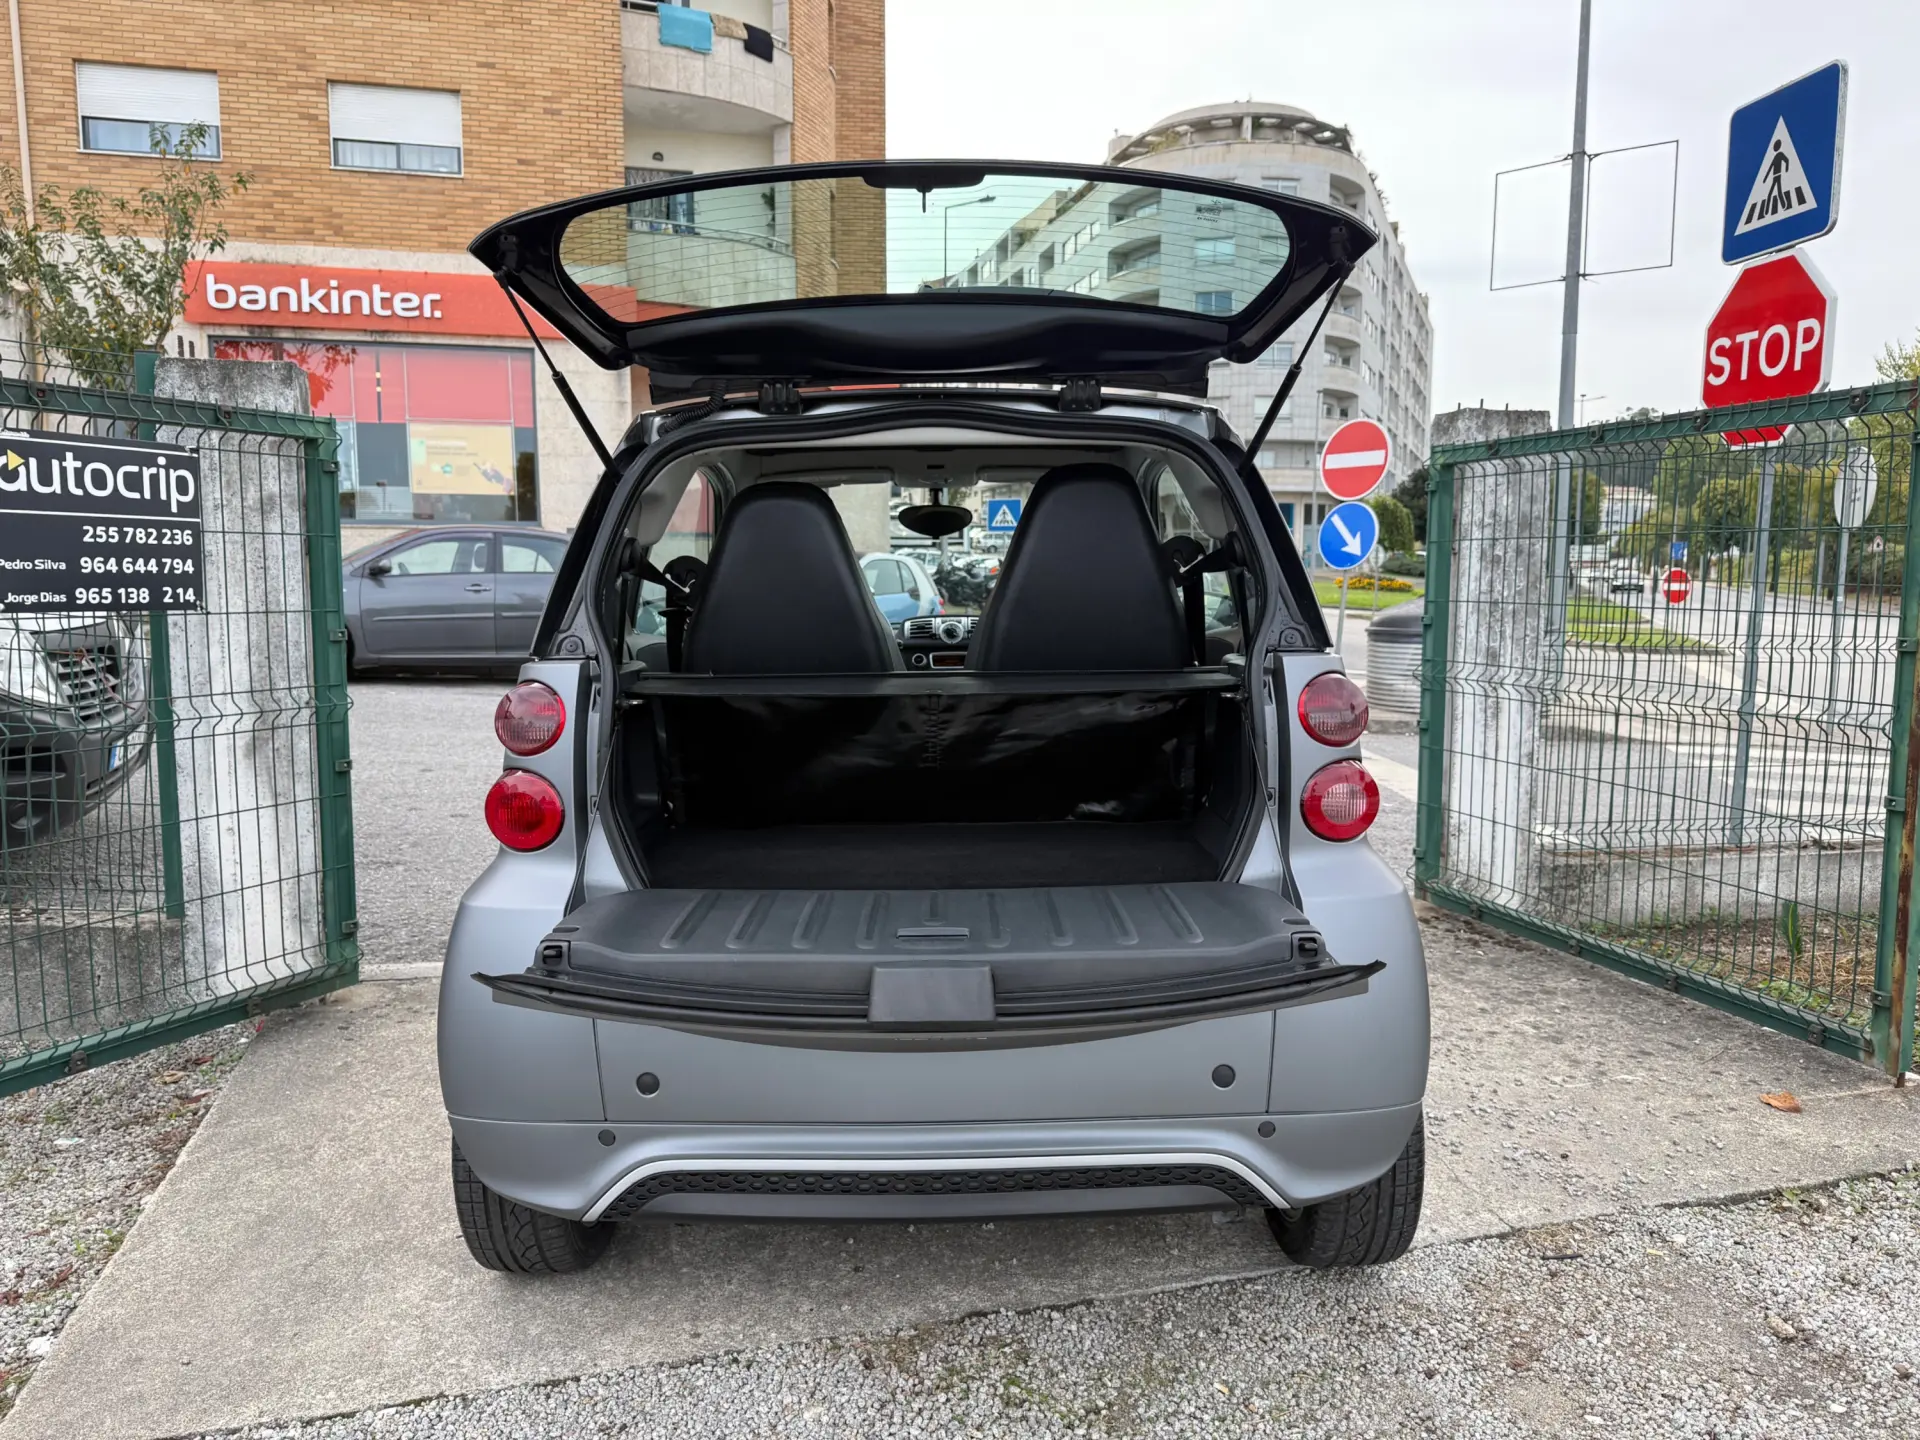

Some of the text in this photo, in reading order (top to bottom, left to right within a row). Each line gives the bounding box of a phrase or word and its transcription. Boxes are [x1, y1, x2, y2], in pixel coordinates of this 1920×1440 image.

[205, 273, 443, 319] bankinter.
[1706, 317, 1821, 386] STOP
[0, 451, 196, 513] autocrip
[82, 525, 193, 546] 255 782 236
[34, 558, 67, 571] Silva
[79, 556, 119, 574] 964
[122, 557, 158, 574] 644
[161, 558, 195, 575] 794
[4, 592, 39, 606] Jorge
[40, 591, 68, 603] Dias
[74, 587, 113, 605] 965
[117, 587, 150, 604] 138
